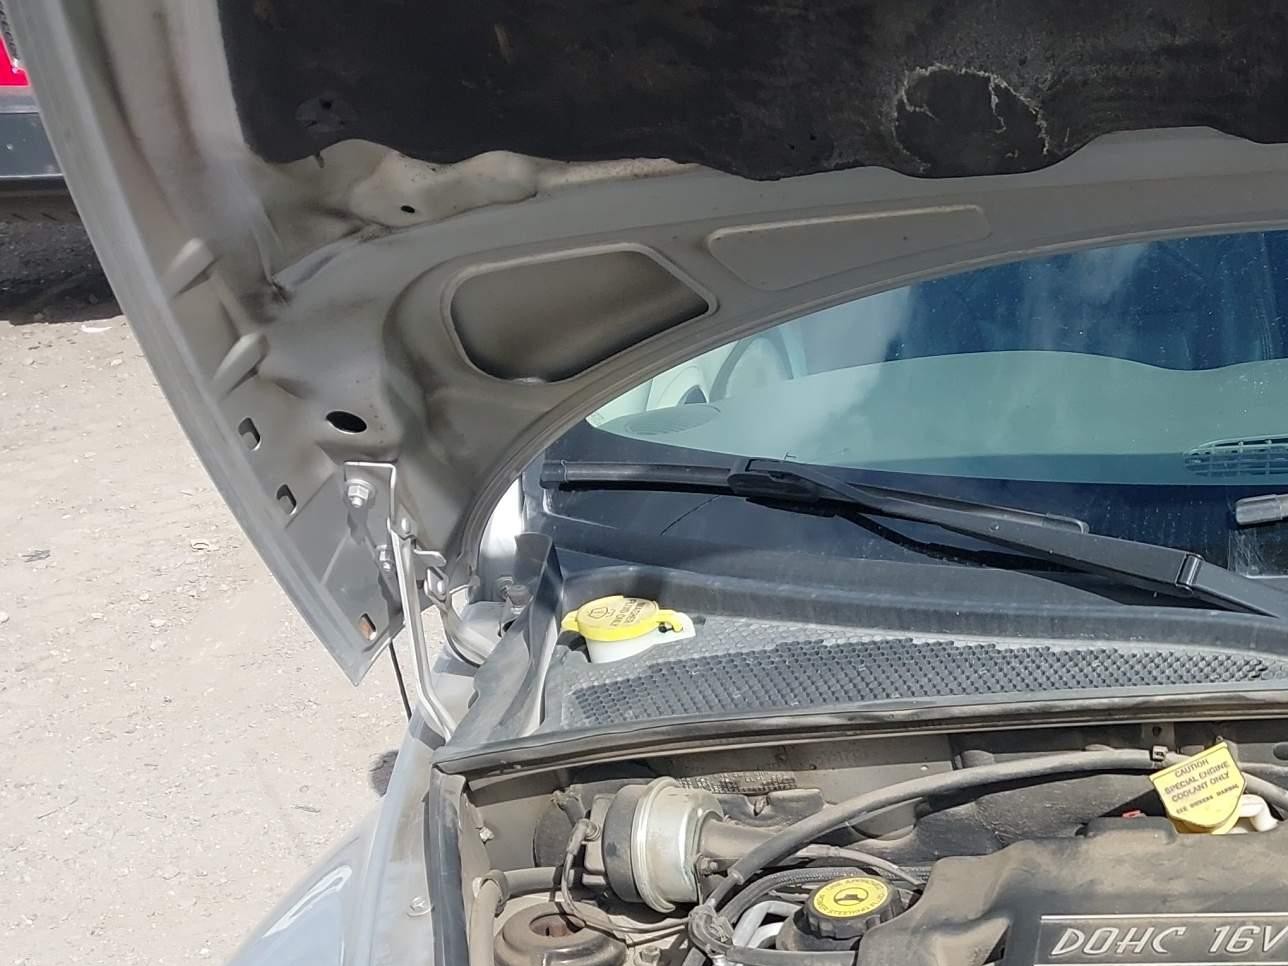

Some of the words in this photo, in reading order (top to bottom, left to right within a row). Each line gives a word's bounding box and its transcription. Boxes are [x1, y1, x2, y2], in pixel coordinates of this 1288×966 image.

[1164, 777, 1198, 794] SPECIAL
[1199, 761, 1230, 779] ENGINE
[1174, 759, 1209, 778] CAUTION
[1171, 781, 1209, 802] COOLANT
[1210, 771, 1229, 785] ONLY
[1049, 925, 1187, 959] DOHC
